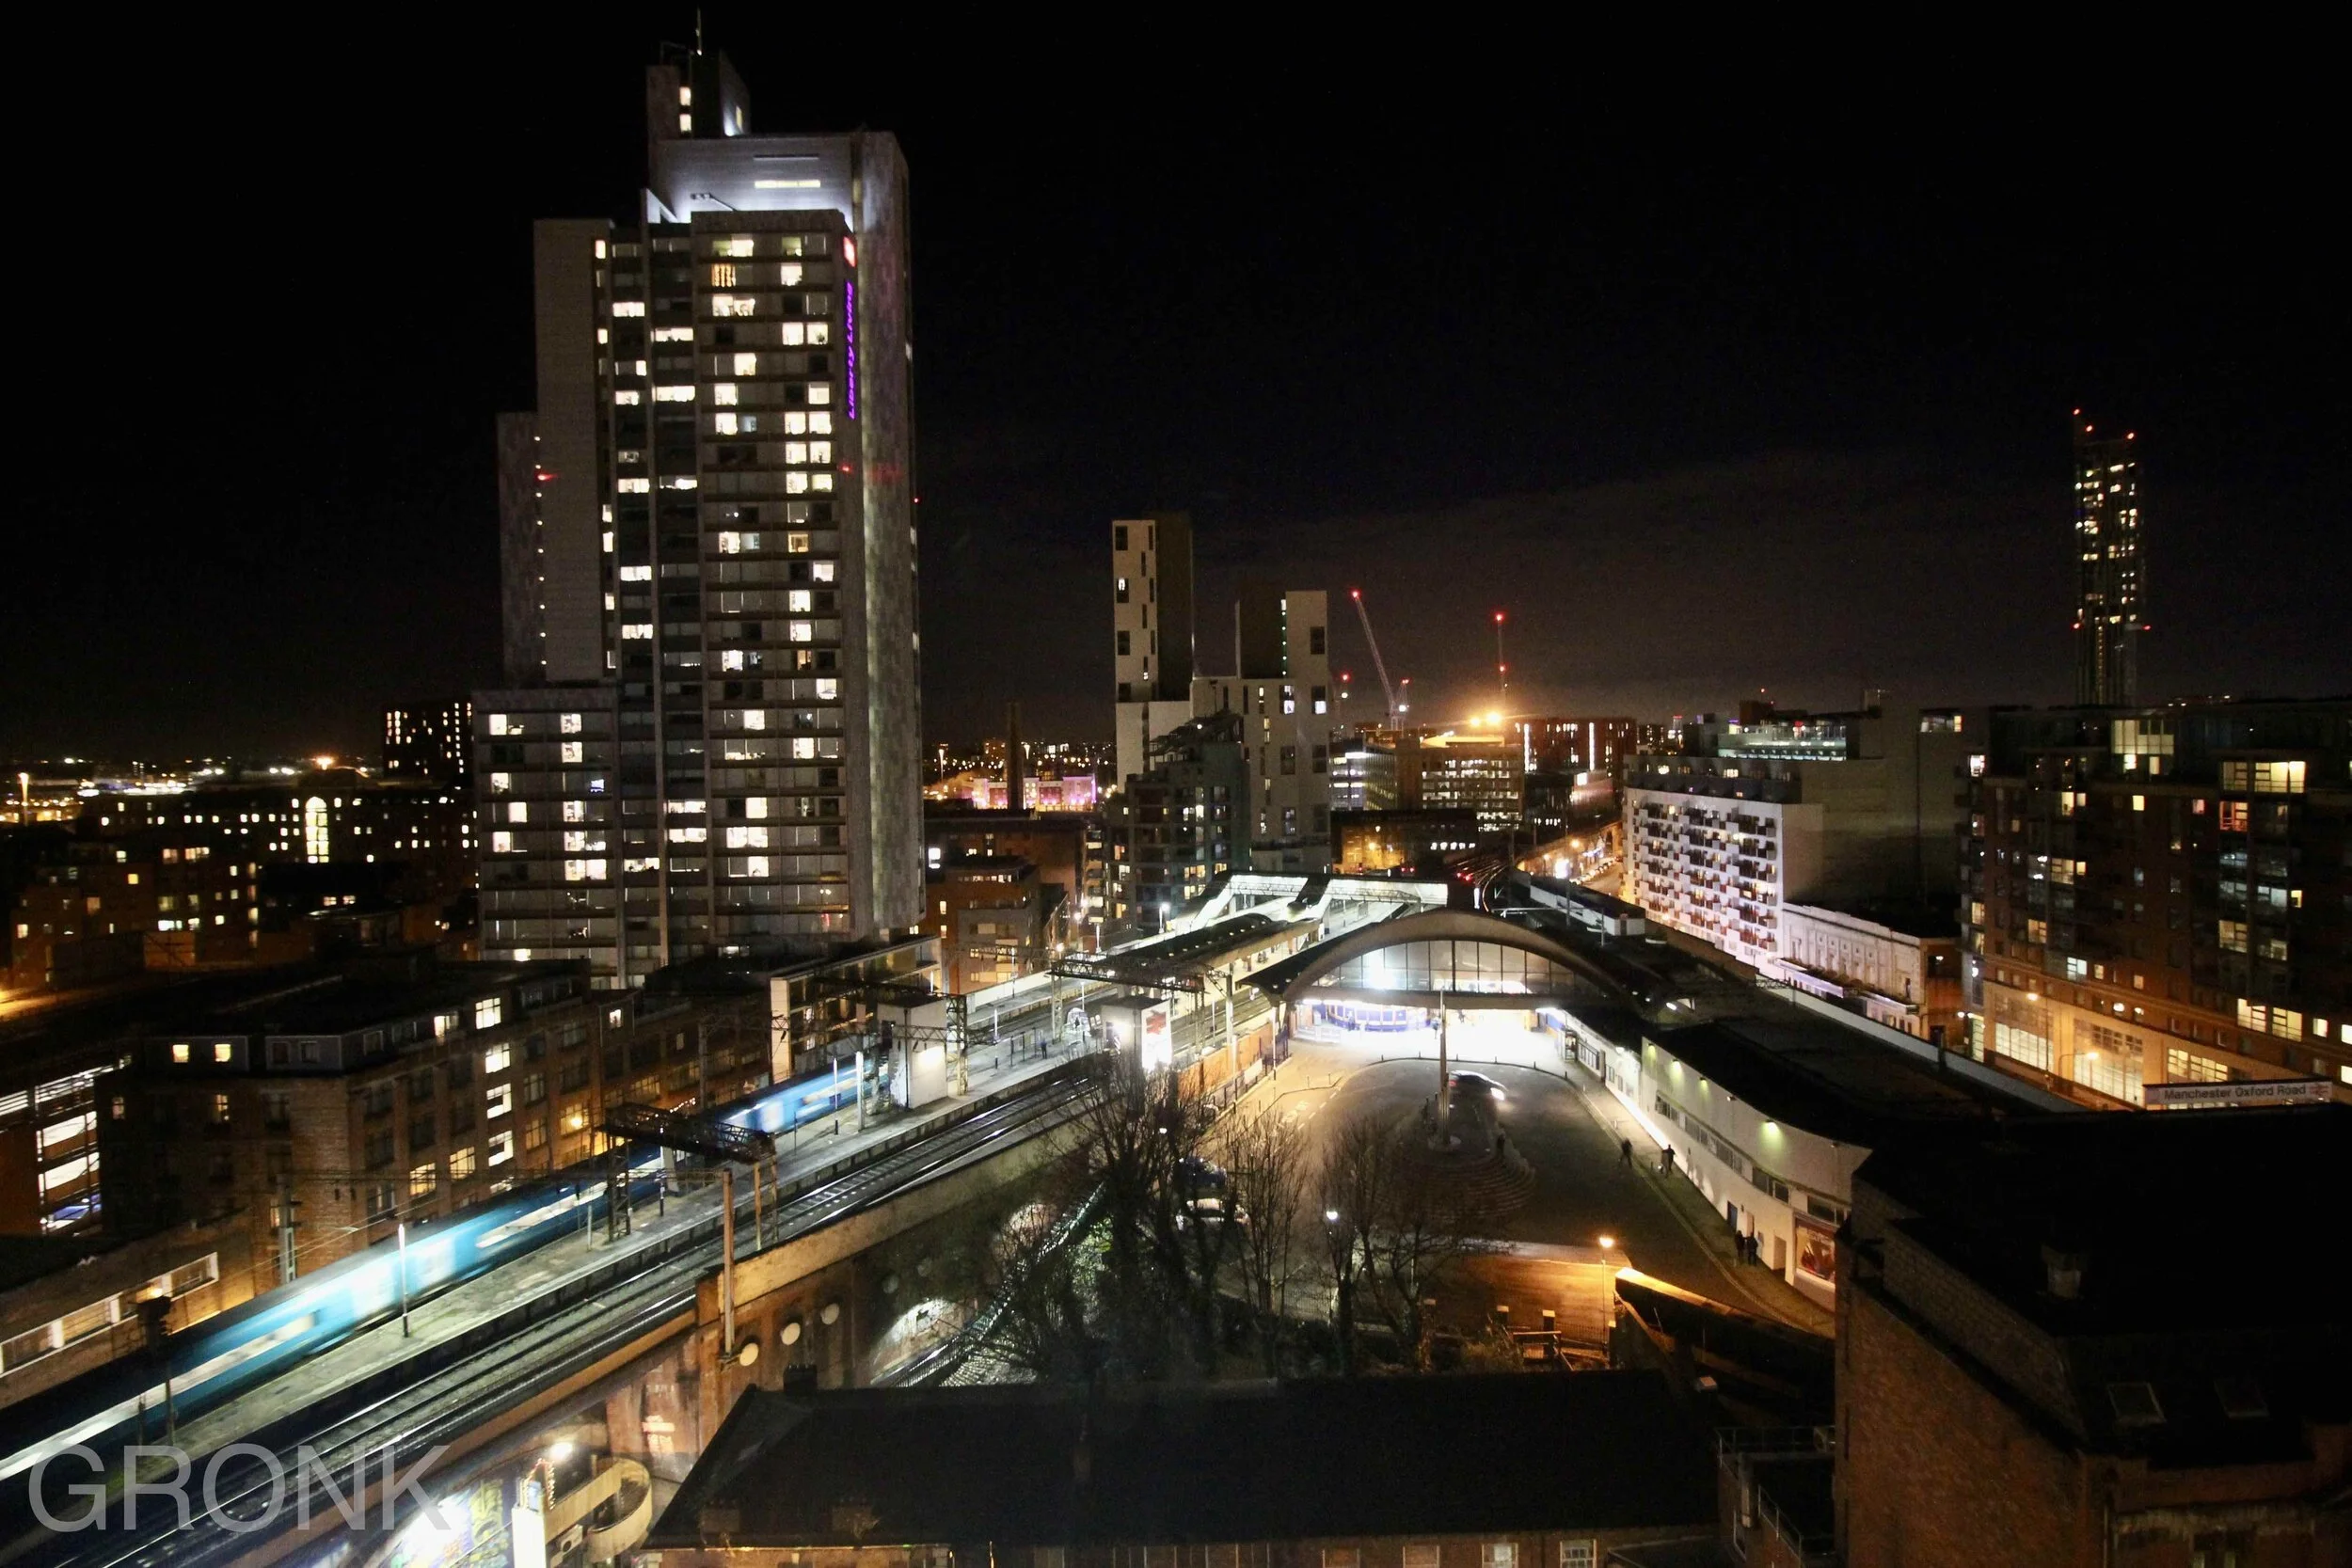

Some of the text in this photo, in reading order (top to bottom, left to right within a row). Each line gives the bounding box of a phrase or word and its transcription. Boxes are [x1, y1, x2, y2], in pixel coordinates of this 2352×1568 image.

[846, 281, 856, 420] Liberty Living
[2165, 1084, 2306, 1101] Manchester Oxford Road
